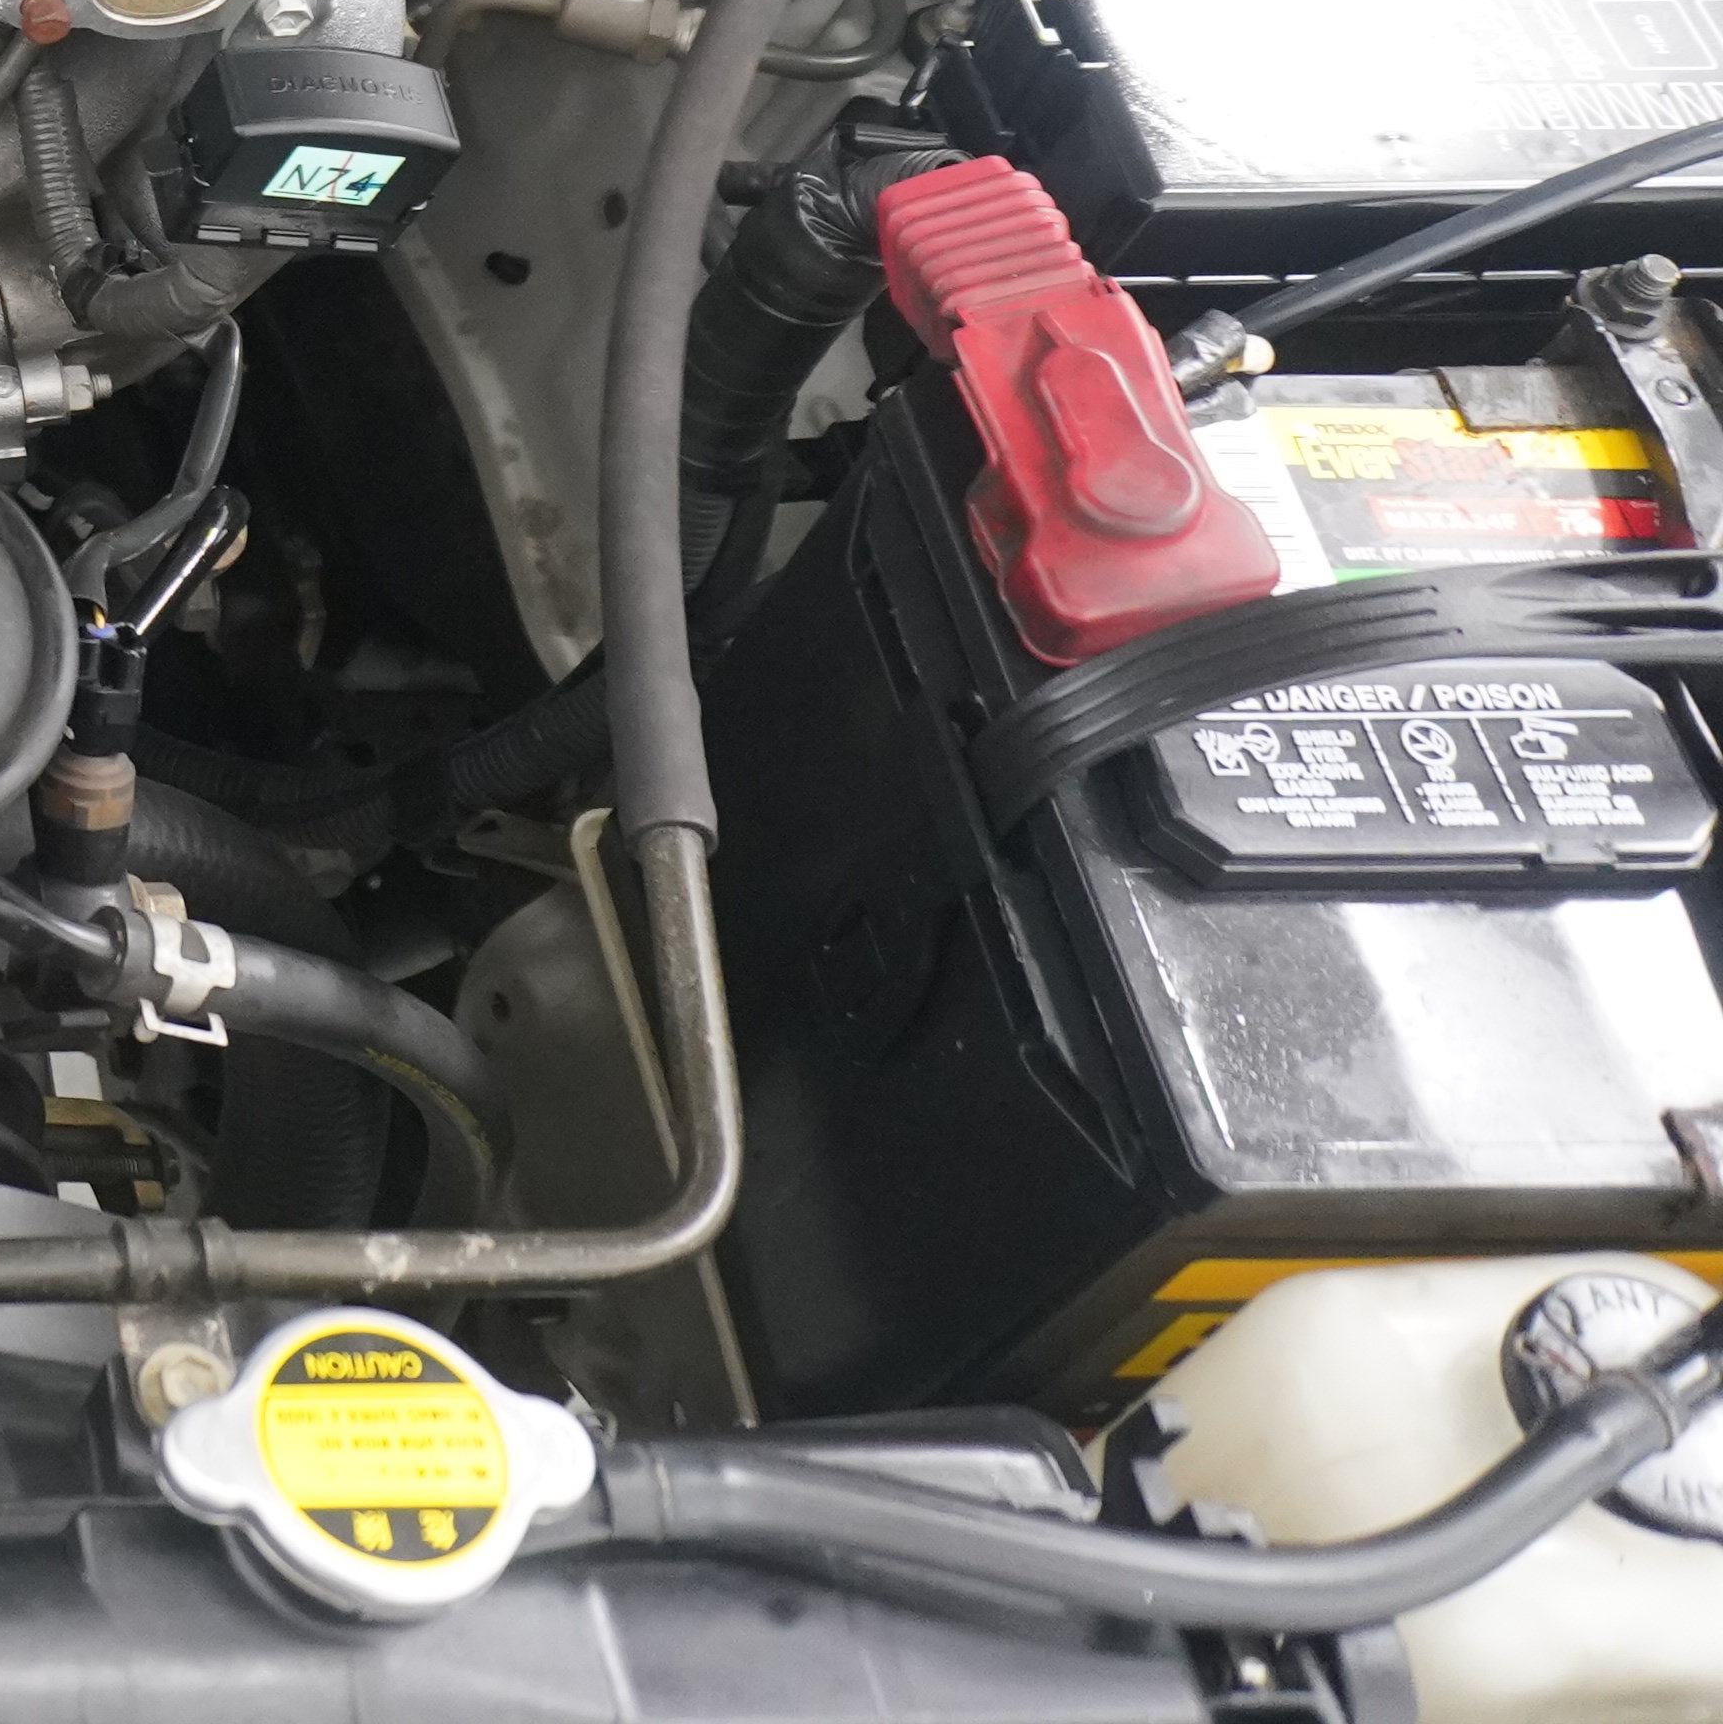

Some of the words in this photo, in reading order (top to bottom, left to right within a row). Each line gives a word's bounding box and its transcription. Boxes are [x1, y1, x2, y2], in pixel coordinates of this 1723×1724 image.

[279, 162, 385, 196] N74
[1313, 422, 1389, 436] maxx
[1295, 435, 1515, 484] EverStart
[1263, 684, 1407, 711] DANGER
[1431, 683, 1564, 710] POISON
[301, 1348, 424, 1379] CAUTION
